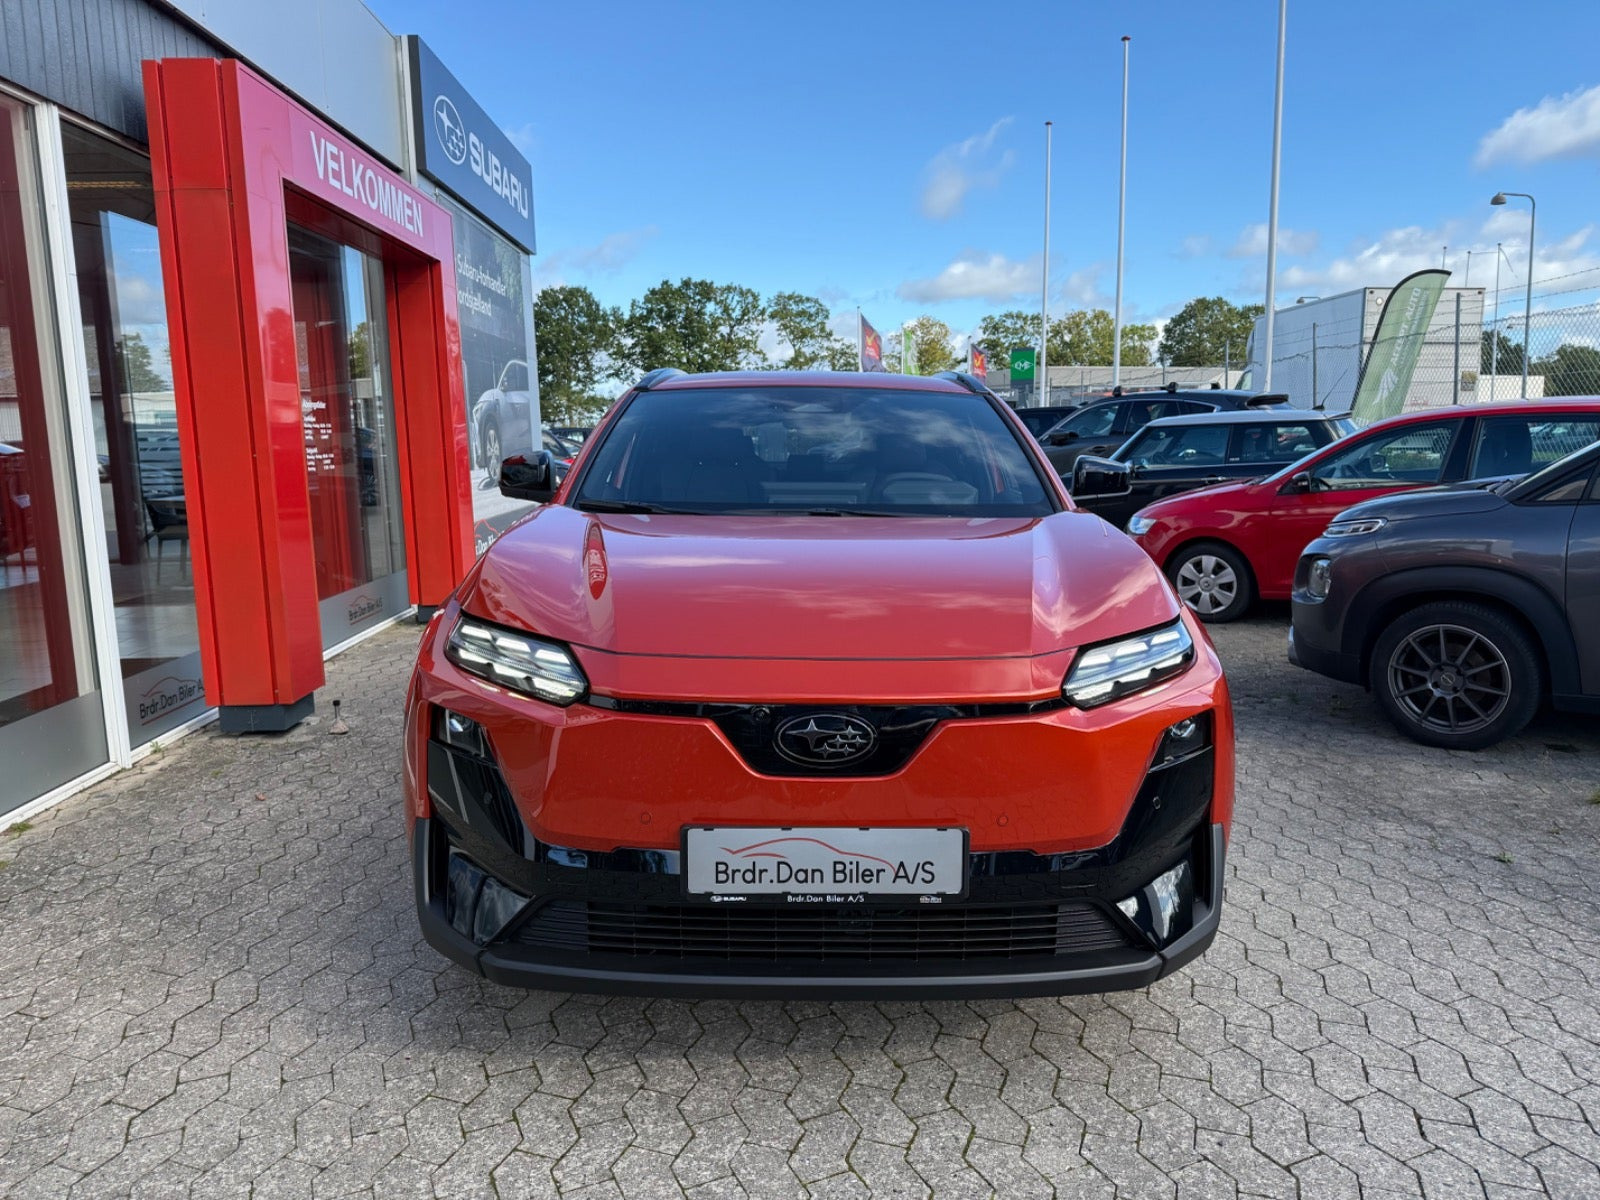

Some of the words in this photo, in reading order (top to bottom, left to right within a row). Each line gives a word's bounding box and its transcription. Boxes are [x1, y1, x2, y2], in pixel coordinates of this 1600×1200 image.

[310, 131, 423, 237] VELKOMMEN
[469, 132, 529, 219] SUBARU
[179, 683, 196, 701] Biler
[714, 861, 824, 885] Brdr.Dan
[832, 861, 886, 884] Biler
[892, 861, 936, 885] A/S
[787, 895, 823, 903] Brdr.Dan
[826, 895, 845, 903] Biler
[847, 895, 865, 903] A/S
